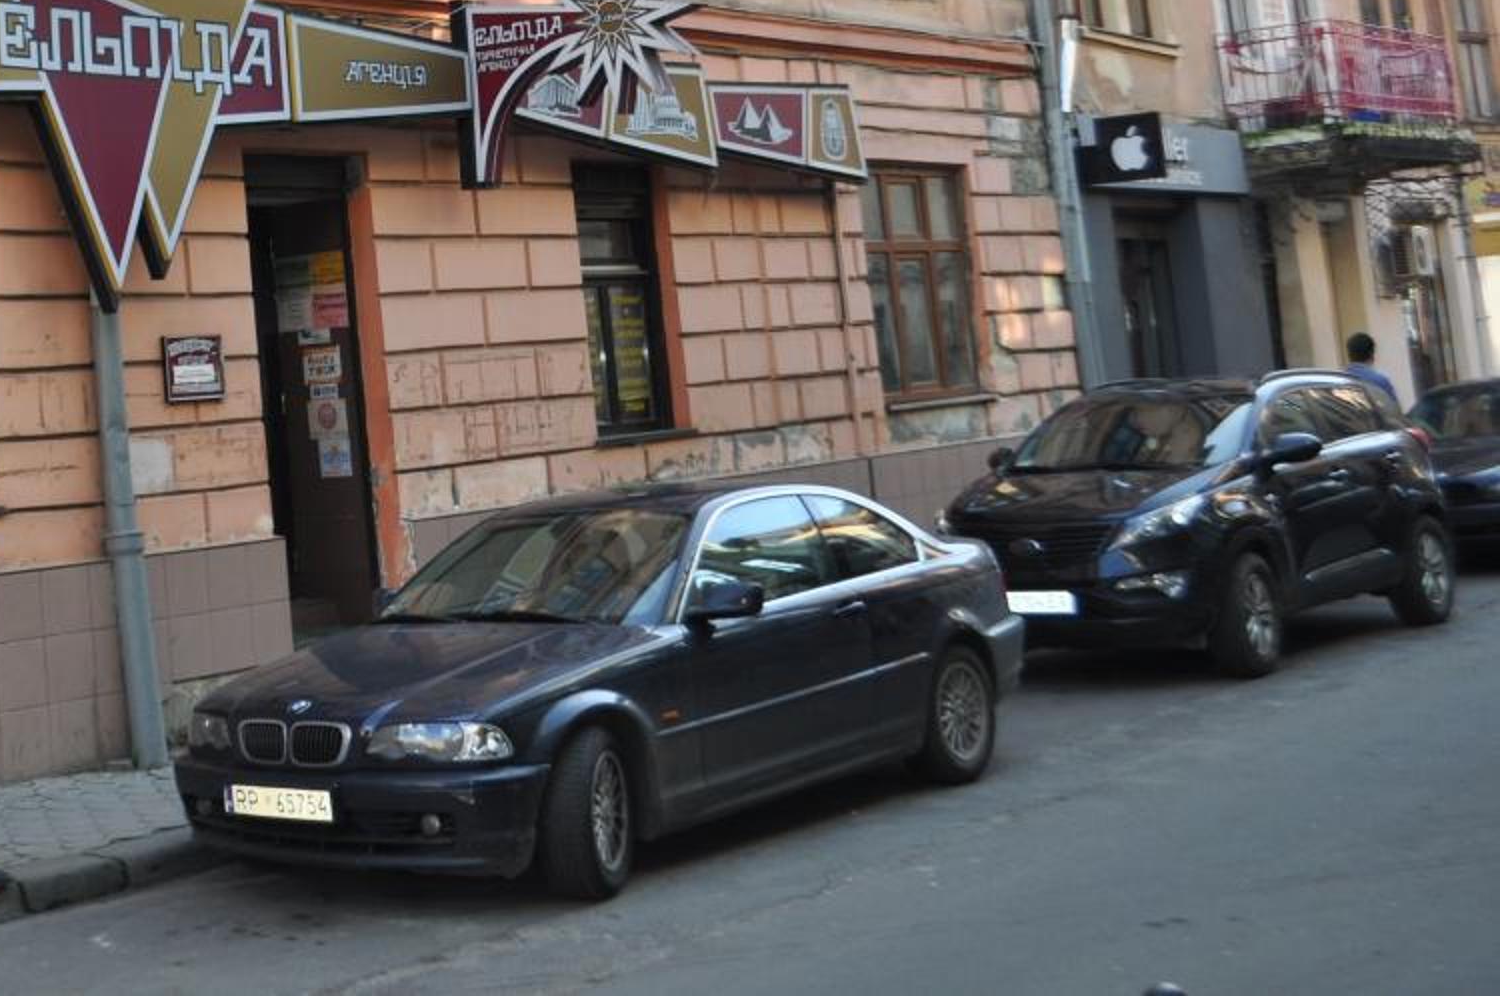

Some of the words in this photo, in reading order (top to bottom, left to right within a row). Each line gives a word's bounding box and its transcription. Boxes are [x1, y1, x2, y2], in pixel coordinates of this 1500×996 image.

[345, 60, 427, 90] АГЕНЦІЯ
[235, 789, 260, 810] RP
[276, 792, 327, 815] 65754
